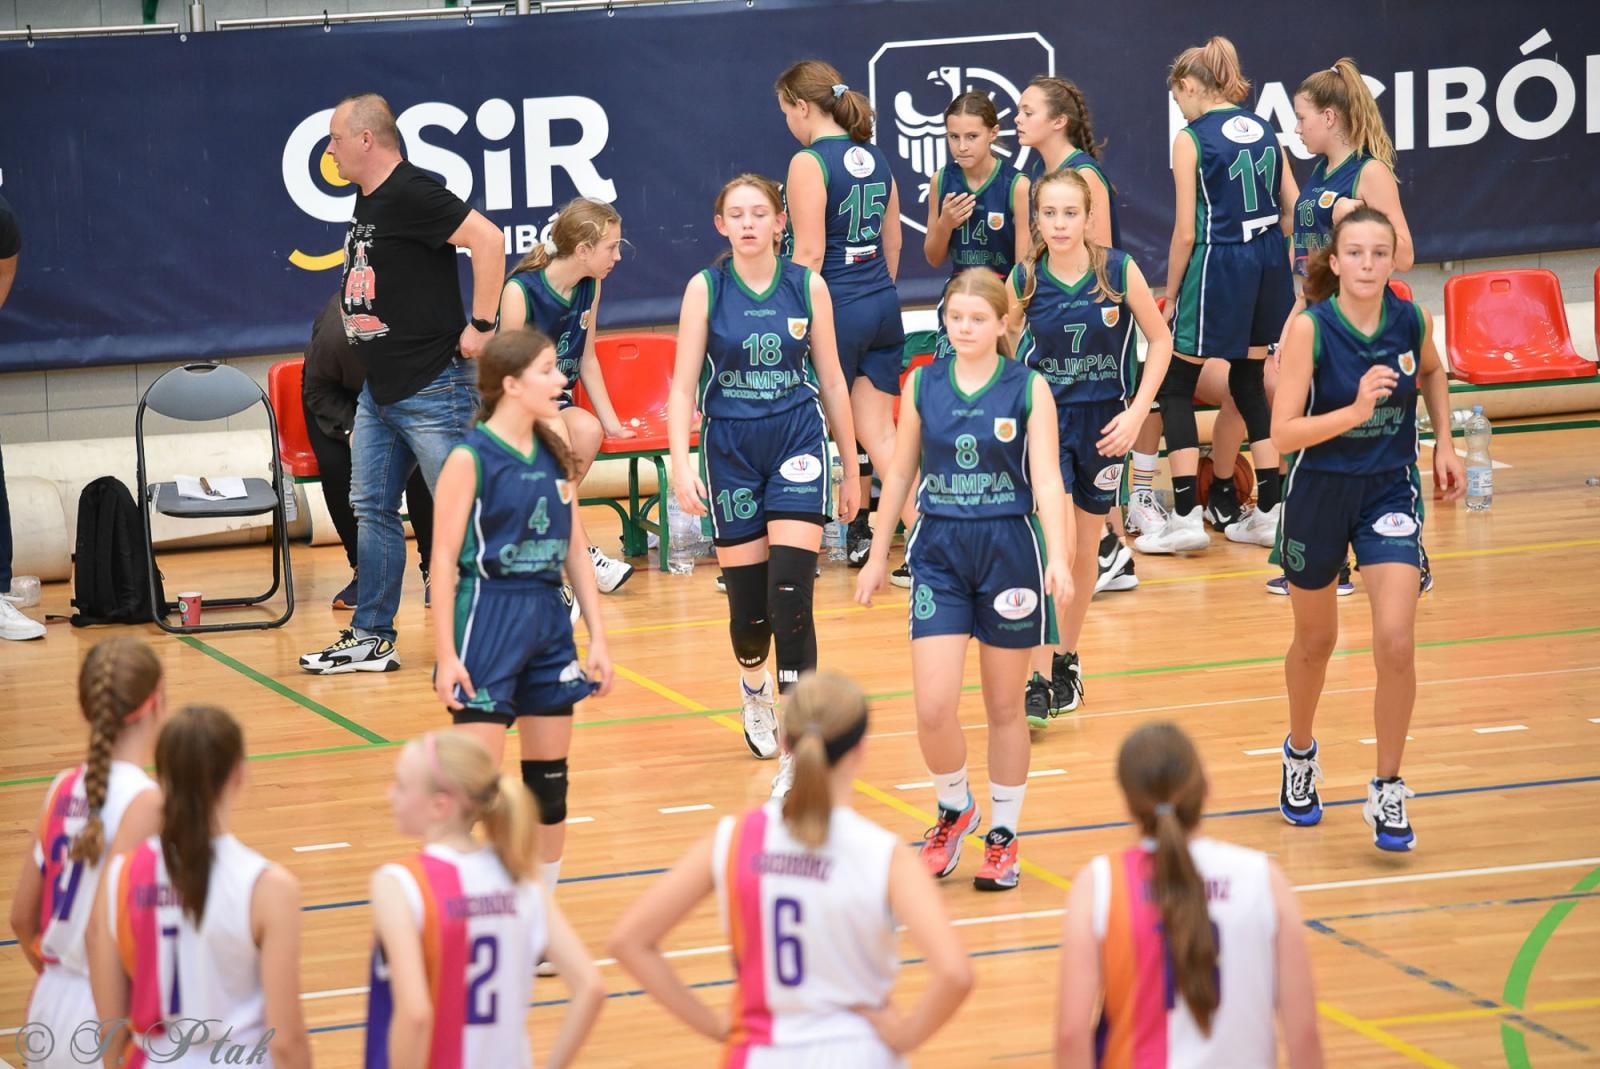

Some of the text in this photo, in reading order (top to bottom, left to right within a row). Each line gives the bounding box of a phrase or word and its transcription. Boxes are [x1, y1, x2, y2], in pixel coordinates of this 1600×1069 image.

[1228, 146, 1277, 212] 11
[839, 182, 887, 242] 15
[1297, 199, 1316, 227] 16
[955, 218, 988, 245] 14
[556, 331, 571, 356] 6
[742, 332, 782, 366] 18
[1063, 323, 1087, 353] 7
[718, 369, 801, 389] OLIMPIA
[1039, 353, 1118, 376] OLIMPIA
[955, 433, 980, 470] 8
[926, 471, 1015, 495] OLIMPIA
[528, 495, 551, 535] 4
[716, 487, 758, 522] 18
[1286, 538, 1306, 572] 5
[914, 583, 937, 620] 8
[775, 897, 804, 986] 6
[466, 935, 498, 1025] 2
